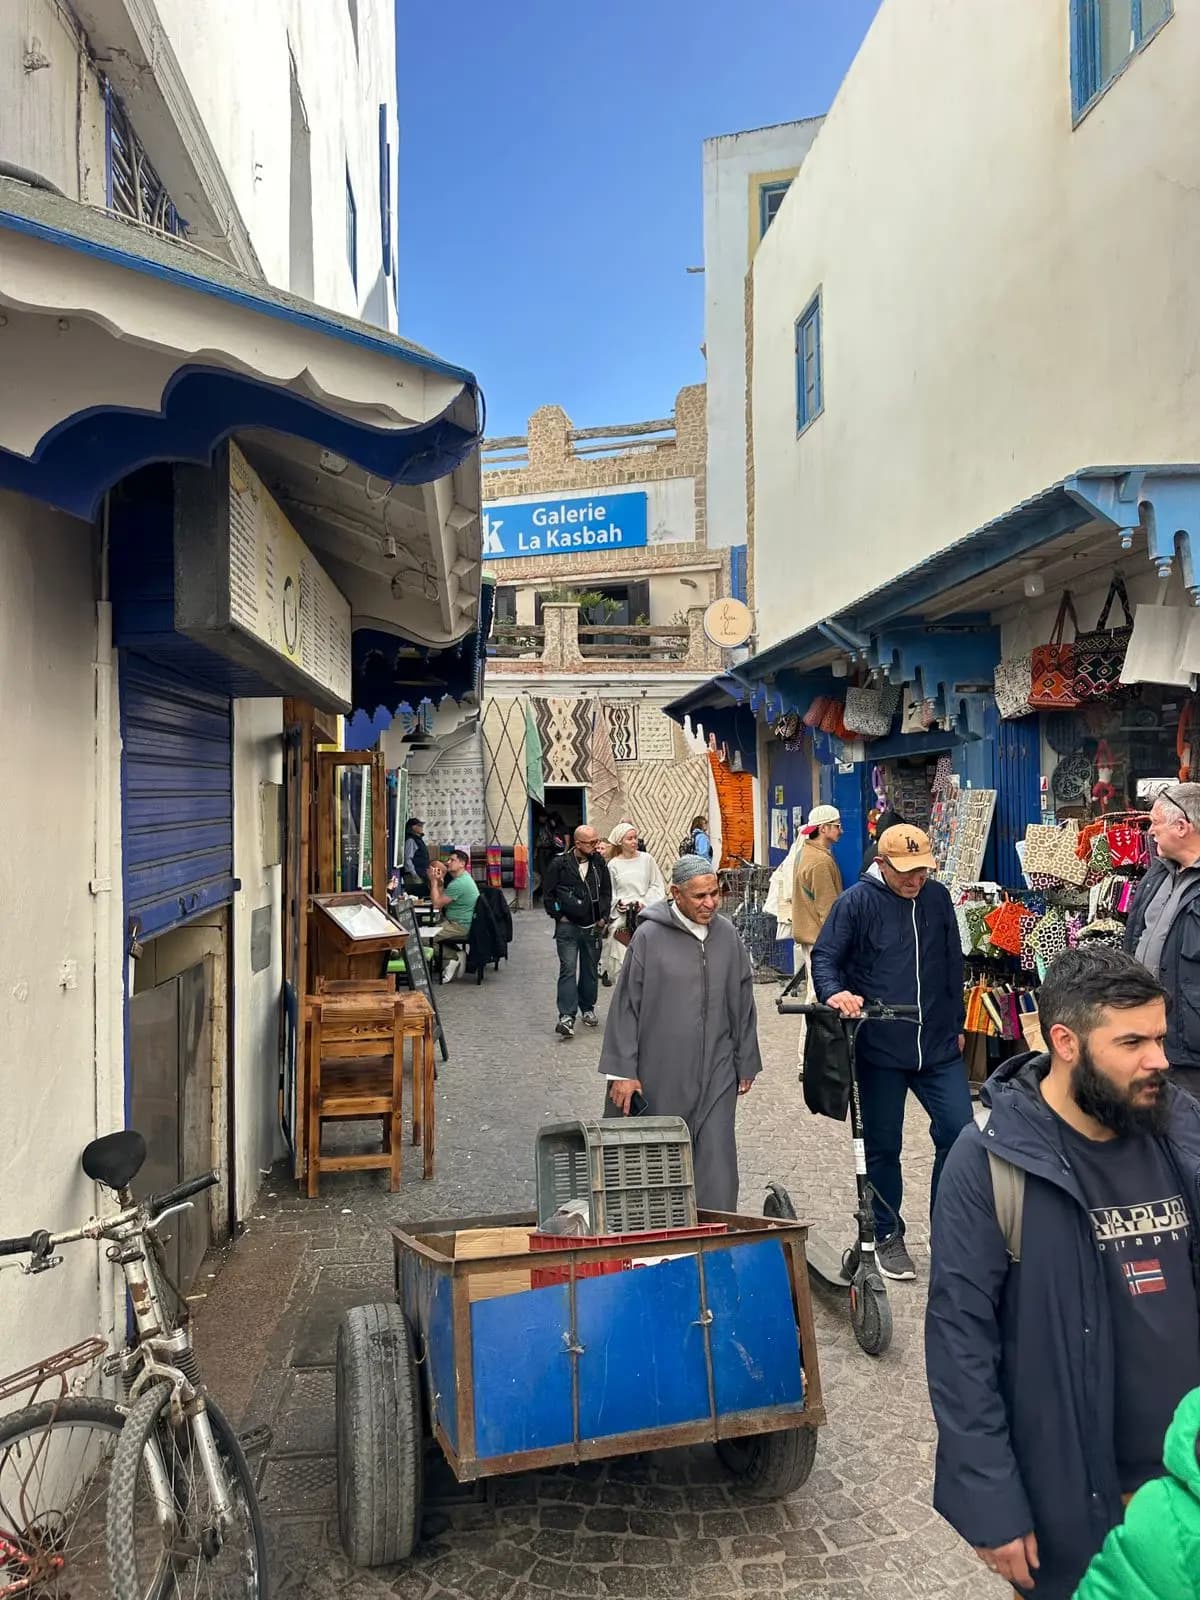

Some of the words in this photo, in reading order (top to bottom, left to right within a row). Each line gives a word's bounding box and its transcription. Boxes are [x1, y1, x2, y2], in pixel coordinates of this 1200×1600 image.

[532, 503, 607, 526] Galerie
[518, 532, 541, 551] La
[547, 523, 623, 548] Kasbah
[905, 836, 919, 852] LA
